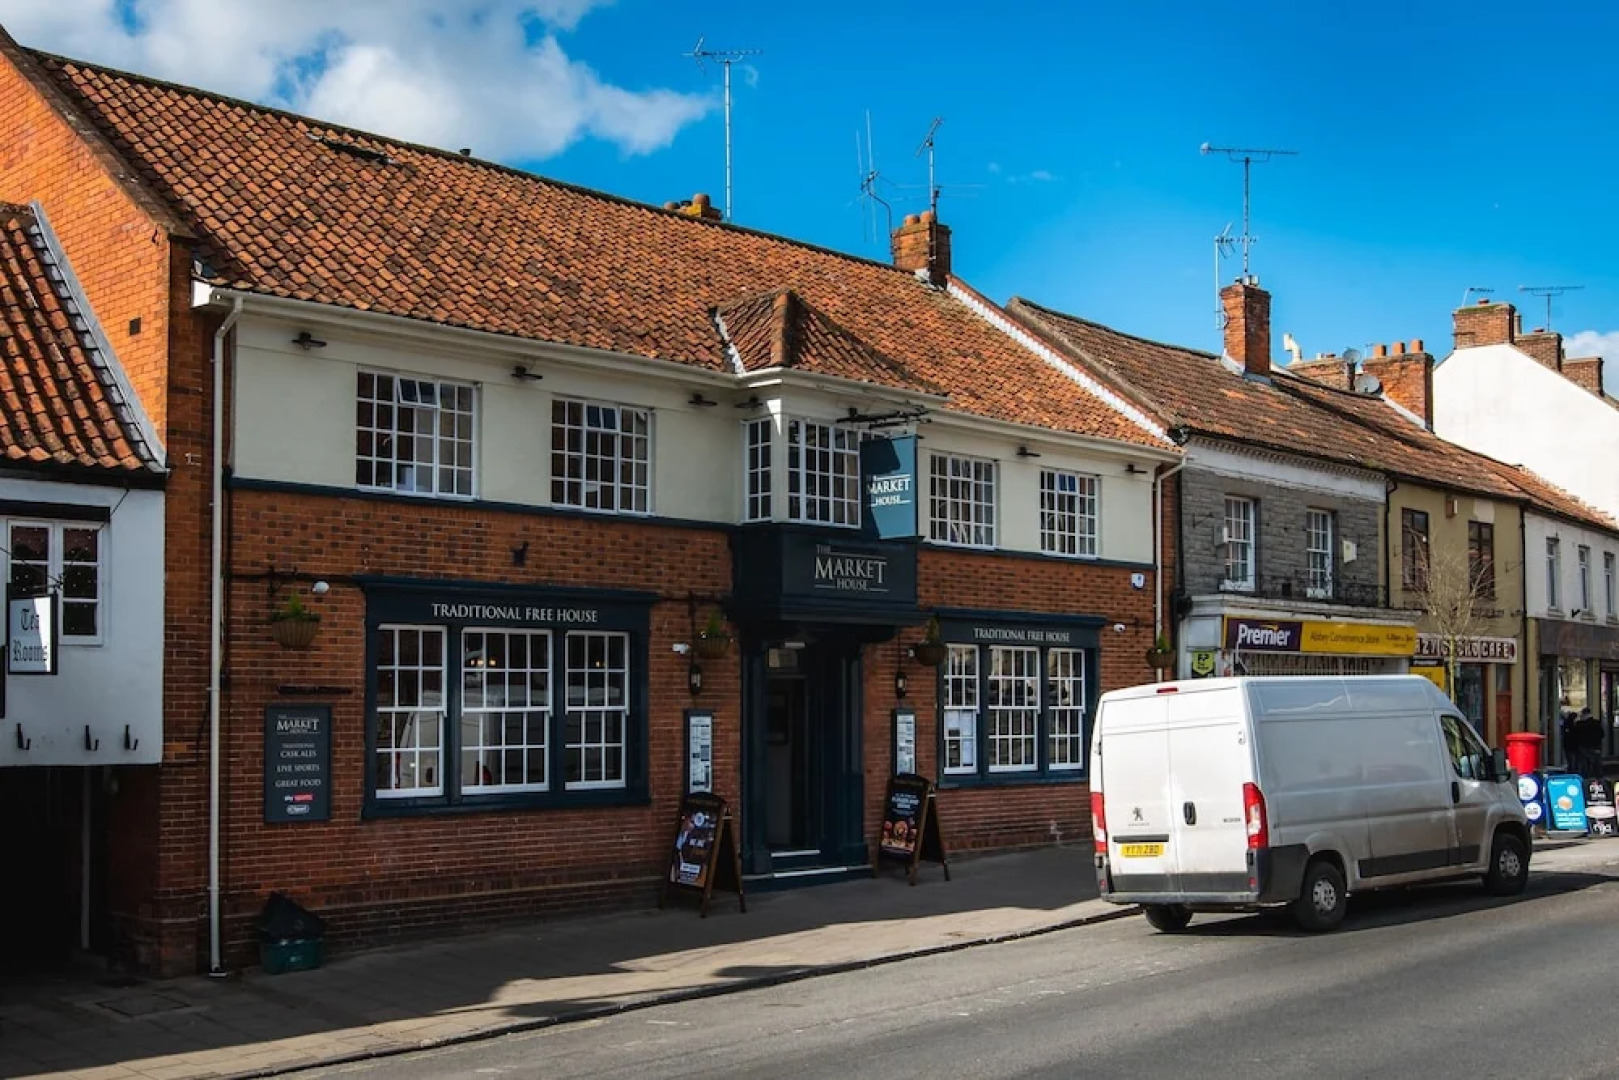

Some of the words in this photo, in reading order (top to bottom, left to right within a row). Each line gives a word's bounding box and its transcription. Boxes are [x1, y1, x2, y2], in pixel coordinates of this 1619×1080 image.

[866, 479, 911, 494] MARKET
[875, 495, 901, 506] HOUSE
[815, 556, 888, 584] MARKET
[836, 577, 868, 590] HOUSE
[20, 608, 40, 631] Tea
[431, 603, 522, 620] TRADITIONAL
[525, 607, 553, 621] FREE
[556, 608, 599, 623] HOUSE
[973, 627, 1026, 641] TRADITIONAL
[1027, 630, 1044, 642] FREE
[1045, 631, 1070, 643] HOUSE
[1238, 623, 1291, 646] Premier
[13, 639, 48, 662] Rooms
[1481, 641, 1511, 659] CAFE
[276, 718, 320, 731] MARKET
[274, 779, 299, 788] GREAT
[300, 778, 321, 787] FOOD
